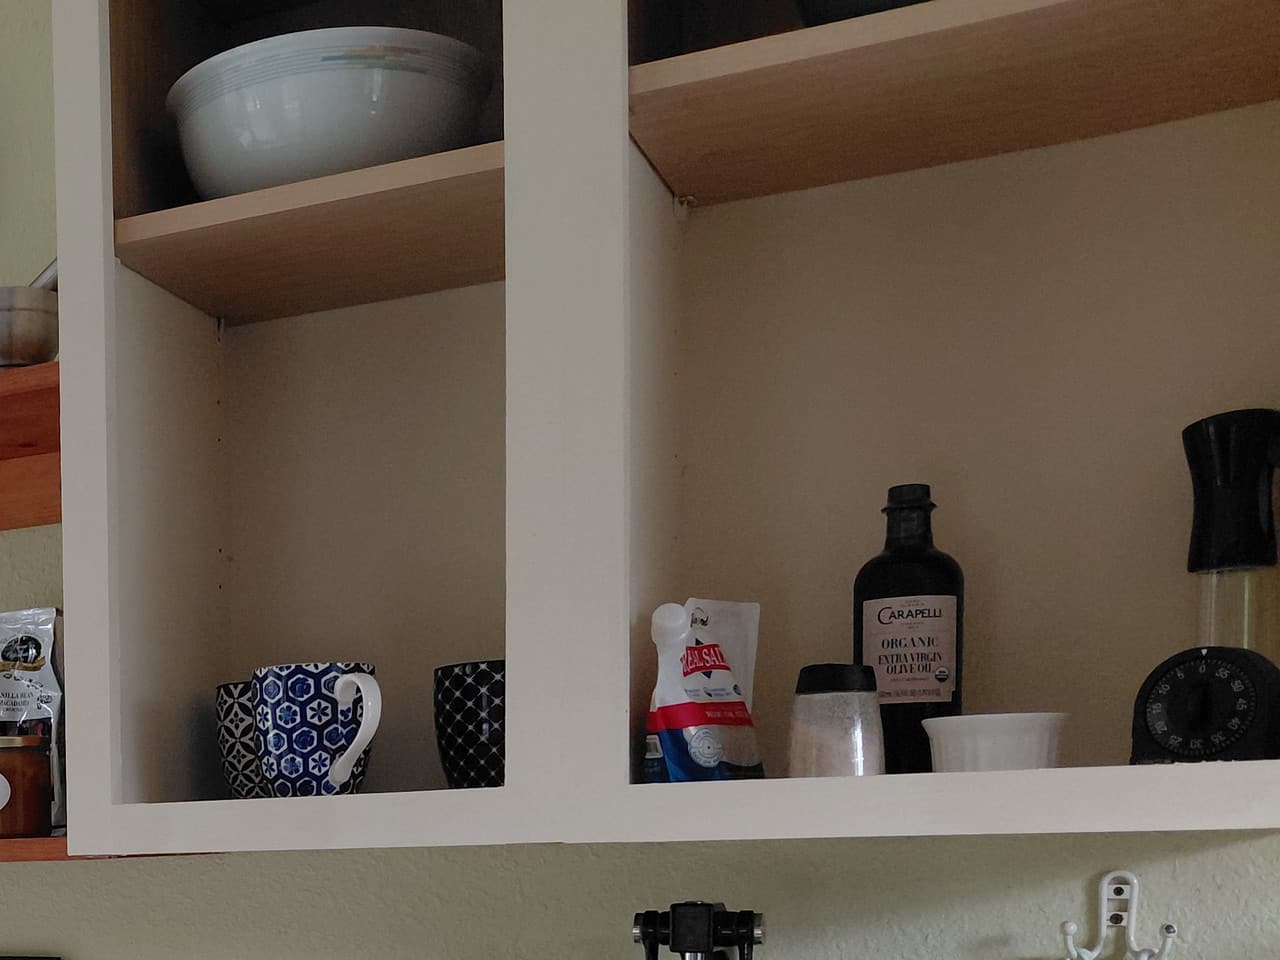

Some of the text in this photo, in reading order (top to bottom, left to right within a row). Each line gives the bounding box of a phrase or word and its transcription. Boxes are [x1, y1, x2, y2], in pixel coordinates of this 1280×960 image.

[877, 606, 943, 625] CARAPELLI
[881, 636, 939, 649] ORGANIC
[682, 648, 703, 673] REAL
[878, 651, 943, 665] EXTRA VIRGIN
[886, 662, 934, 675] OLIVE OIL
[1198, 664, 1206, 673] 0
